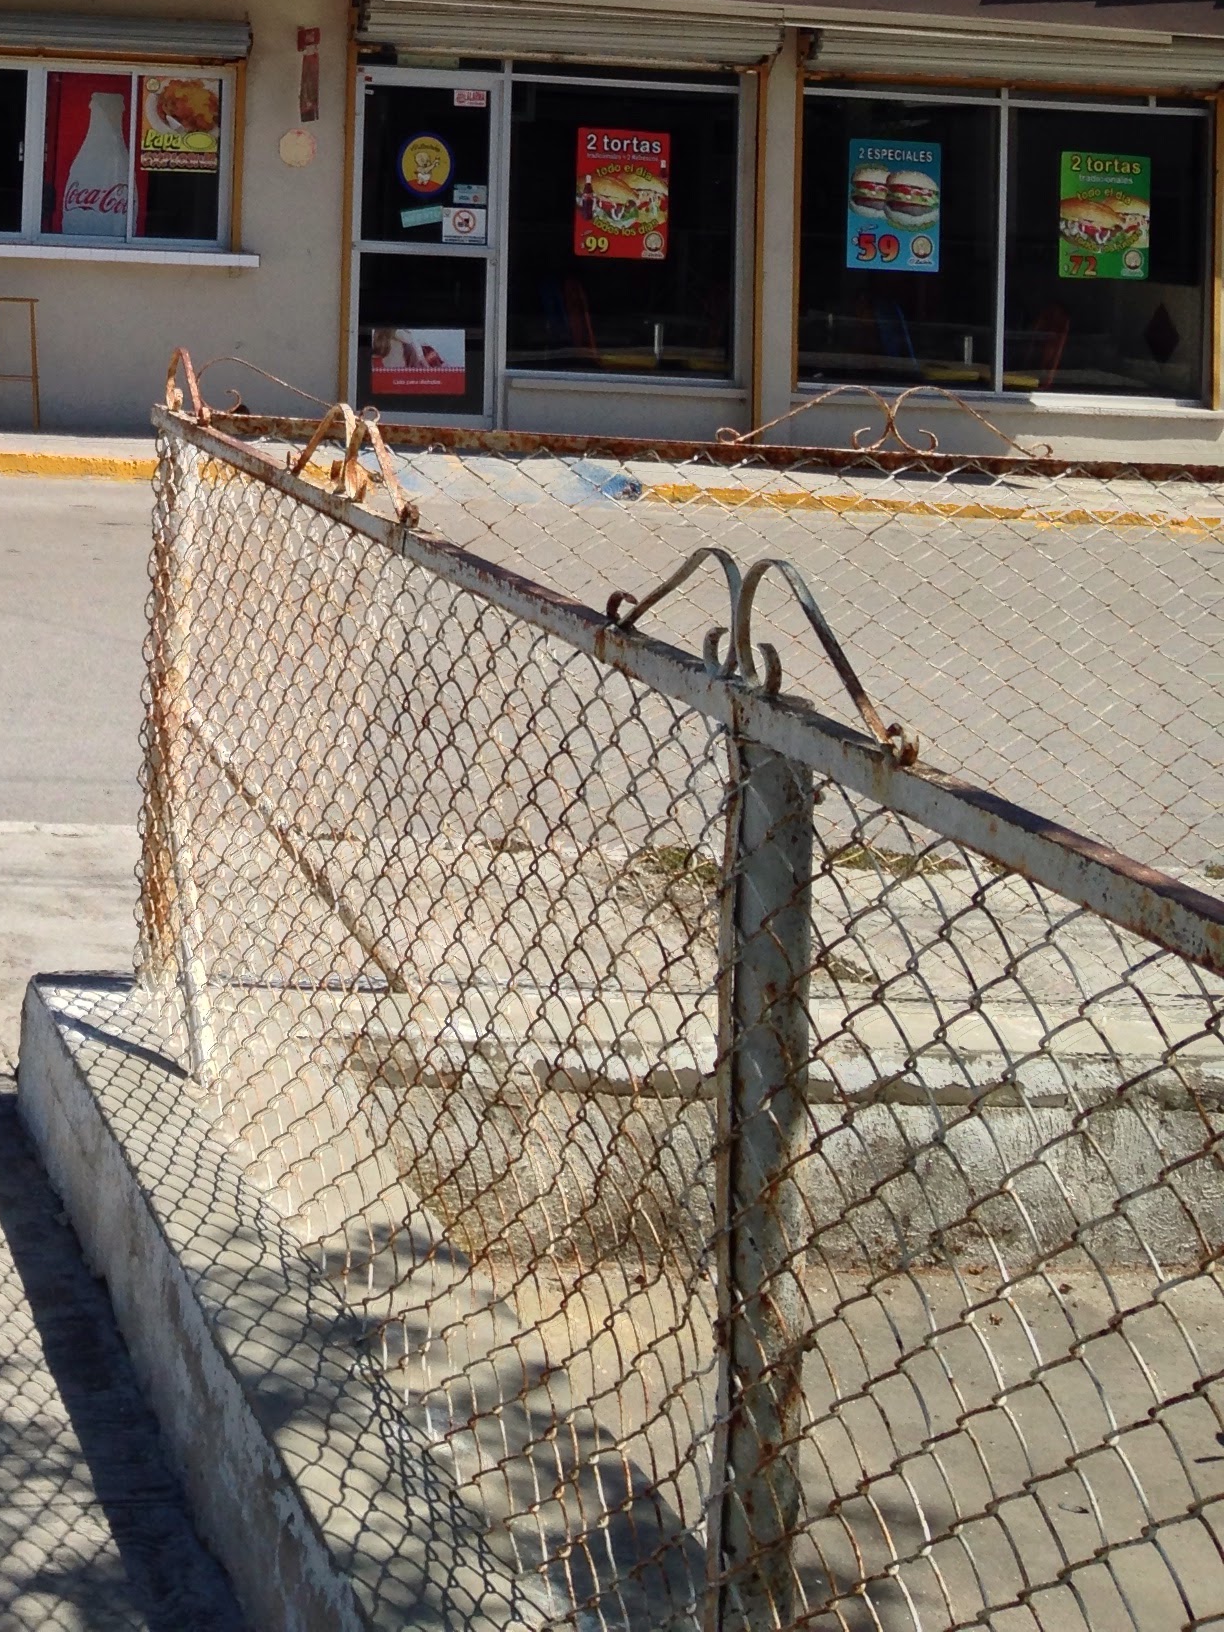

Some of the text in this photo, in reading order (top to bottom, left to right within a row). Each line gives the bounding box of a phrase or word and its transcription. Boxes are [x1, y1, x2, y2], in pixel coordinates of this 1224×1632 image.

[144, 128, 182, 150] Papa
[586, 133, 662, 154] 2 tortas
[858, 147, 933, 162] 2 ESPECIALES
[596, 163, 621, 177] todo
[623, 164, 634, 172] el
[1071, 155, 1141, 174] 2 tortas
[1079, 174, 1134, 185] tradicionales
[1077, 188, 1101, 200] todo
[1104, 188, 1113, 196] el
